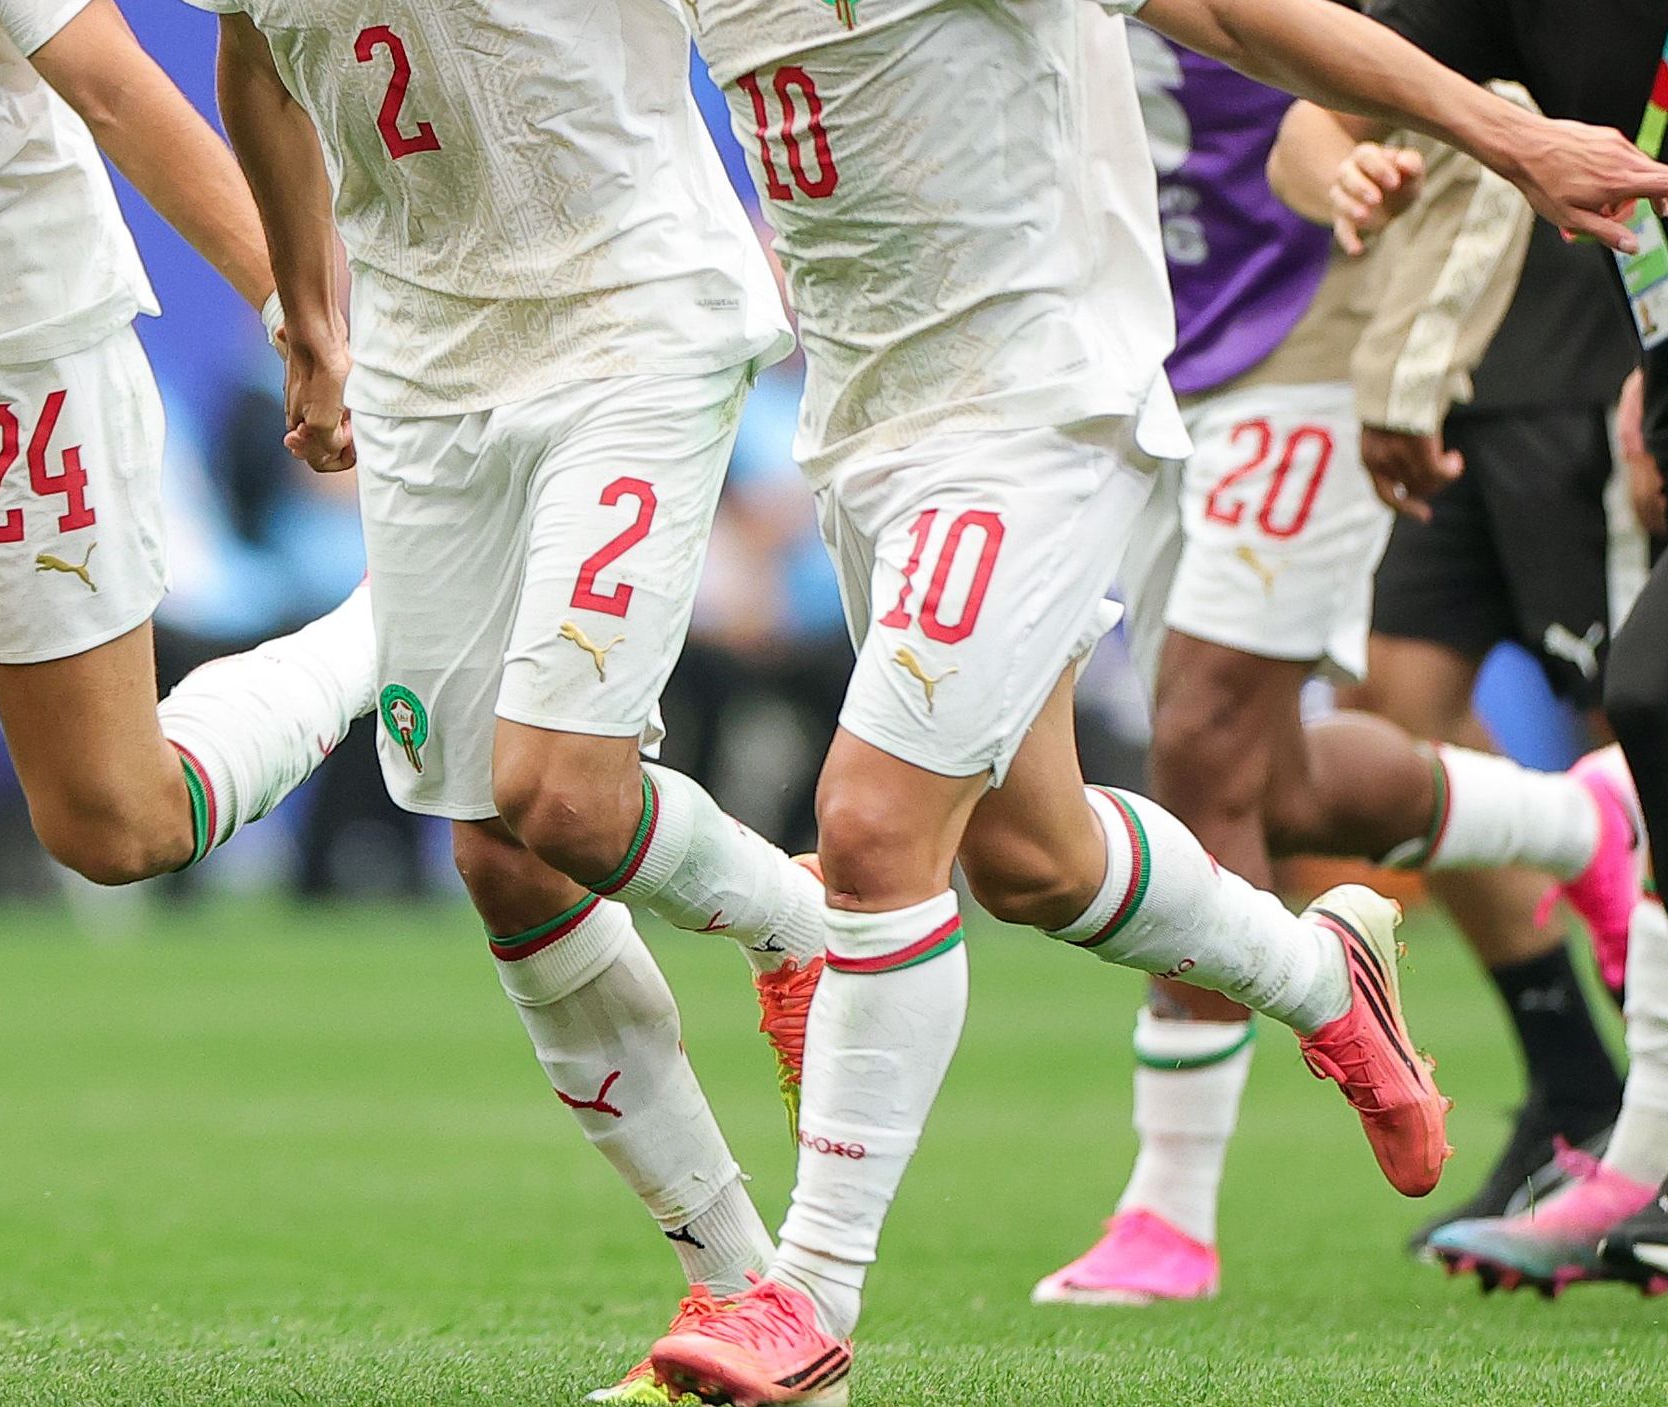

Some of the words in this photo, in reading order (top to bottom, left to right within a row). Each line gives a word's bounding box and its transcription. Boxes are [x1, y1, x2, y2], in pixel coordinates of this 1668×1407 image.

[354, 24, 440, 161] 2
[736, 66, 839, 201] 10
[571, 476, 657, 618] 2
[1204, 418, 1335, 541] 20
[879, 508, 1006, 646] 10
